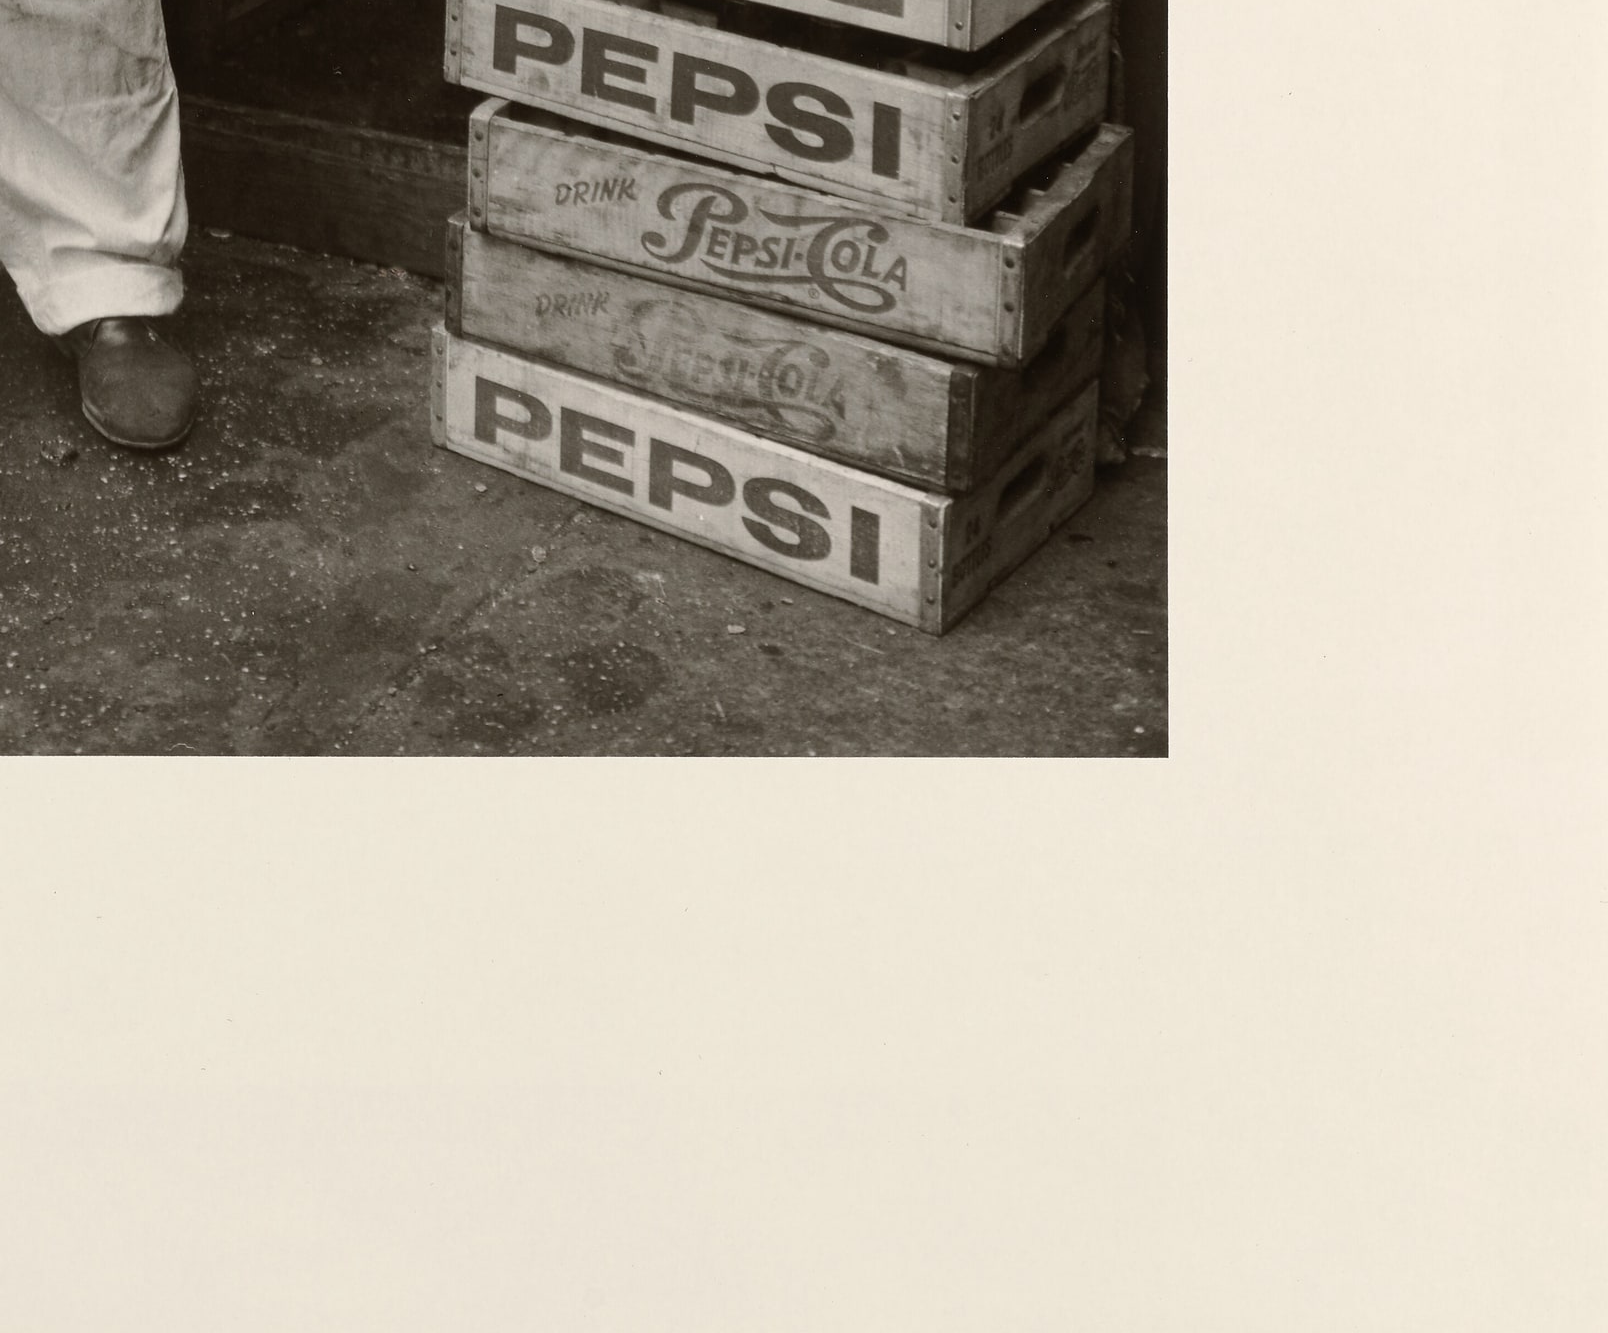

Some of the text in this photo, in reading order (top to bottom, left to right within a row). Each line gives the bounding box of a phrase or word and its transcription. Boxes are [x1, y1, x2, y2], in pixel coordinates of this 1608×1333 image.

[492, 3, 902, 181] PEPSI
[555, 177, 638, 207] DRINK
[534, 290, 611, 317] DRINK
[474, 375, 881, 586] PEPSI
